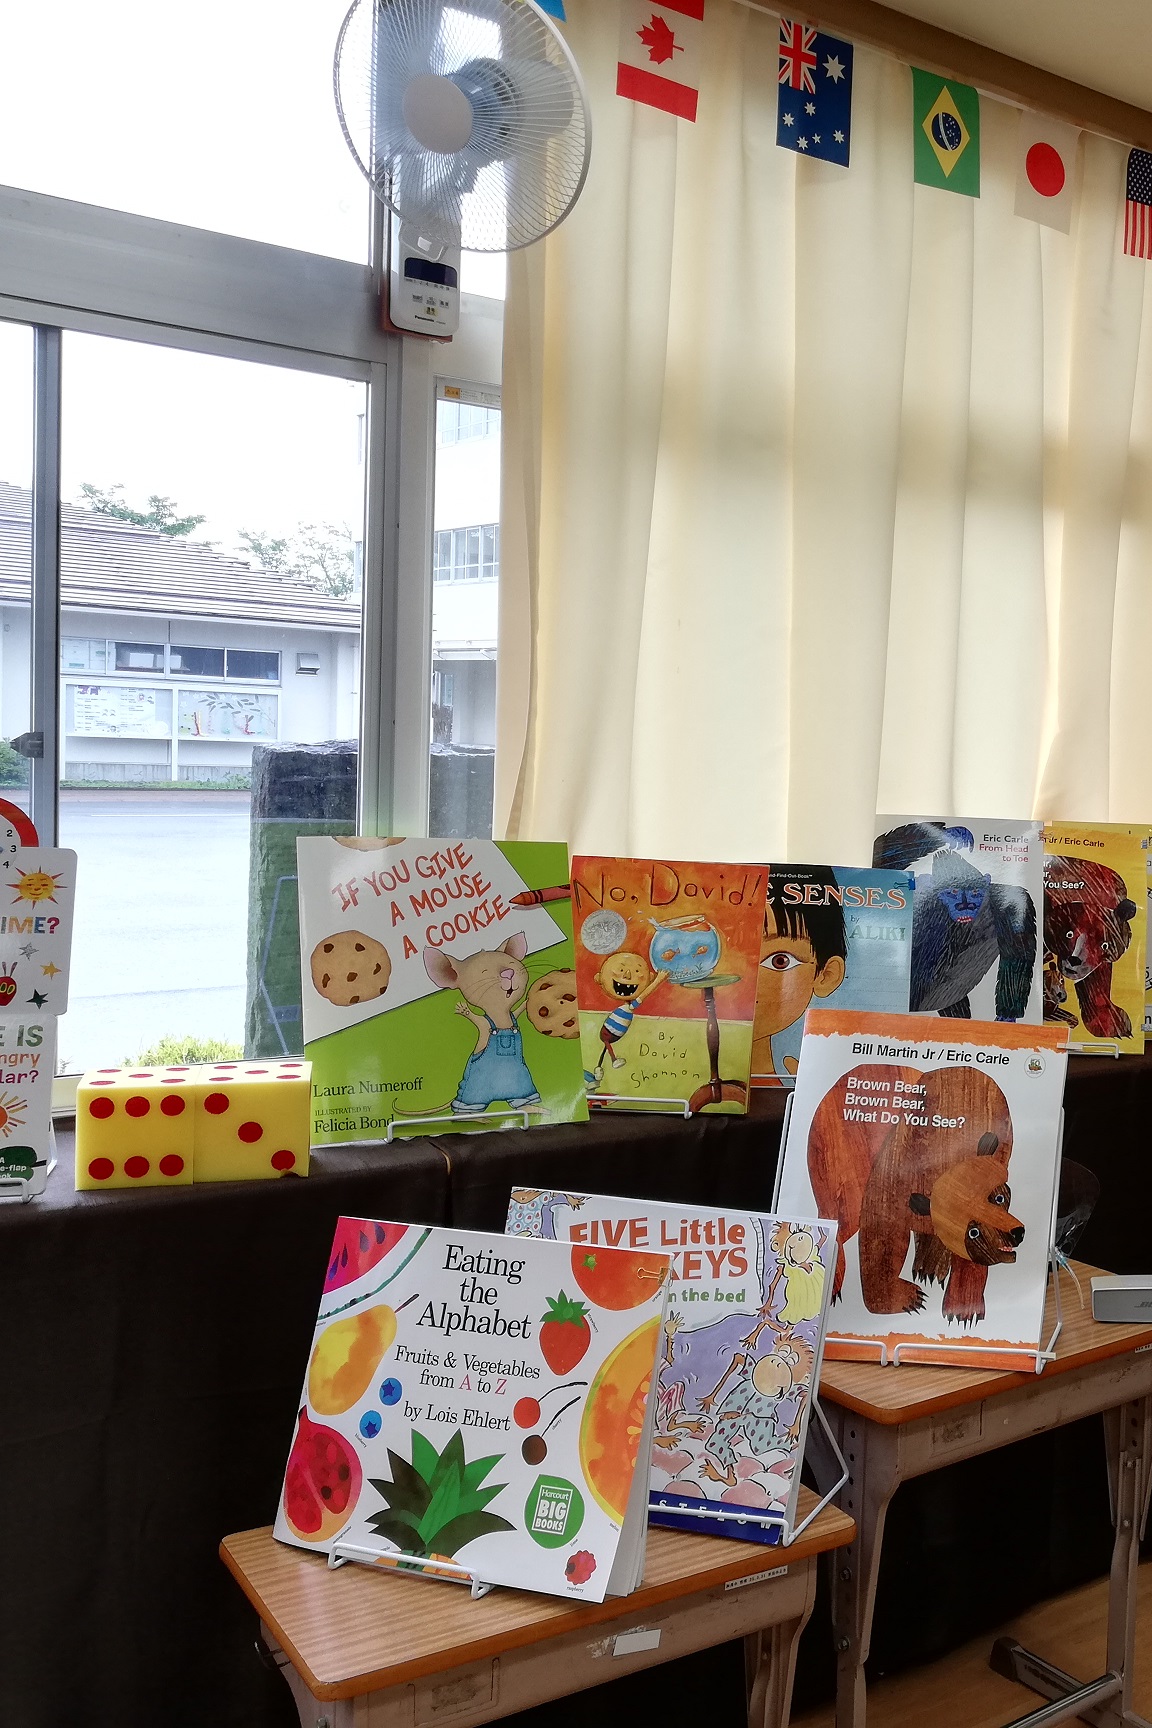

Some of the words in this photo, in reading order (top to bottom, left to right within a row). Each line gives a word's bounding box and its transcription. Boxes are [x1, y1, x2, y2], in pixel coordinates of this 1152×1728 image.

[6, 829, 13, 838] 2
[983, 834, 1001, 843] Eric
[1004, 835, 1029, 844] Carle
[1064, 837, 1081, 846] Eric
[1083, 839, 1105, 848] Carle
[10, 844, 17, 853] 3
[979, 844, 1003, 852] From
[1005, 844, 1029, 853] Head
[2, 860, 10, 869] 4
[1002, 854, 1012, 862] to
[1013, 854, 1029, 863] Toe
[331, 877, 359, 913] IF
[363, 859, 411, 898] YOU
[415, 842, 473, 879] GIVE
[573, 870, 639, 912] No,
[650, 862, 761, 907] David!
[1043, 880, 1060, 889] You
[1062, 880, 1085, 890] See?
[389, 901, 405, 928] A
[408, 871, 492, 918] MOUSE
[782, 883, 907, 910] SENSES
[0, 916, 60, 935] IME?
[402, 934, 418, 960] A
[425, 894, 511, 948] COOKIE
[850, 914, 860, 924] by
[849, 925, 906, 941] ALIKI
[17, 1025, 44, 1048] IS
[658, 1031, 675, 1044] By
[0, 1053, 41, 1069] ngry
[639, 1043, 687, 1060] David
[852, 1042, 874, 1056] Bill
[876, 1044, 918, 1059] Martin
[922, 1048, 936, 1060] Jr
[946, 1050, 972, 1063] Eric
[975, 1052, 1010, 1065] Carle
[313, 1084, 355, 1098] Laura
[359, 1077, 424, 1094] Numeroff
[630, 1068, 700, 1089] Shannon
[847, 1077, 890, 1092] Brown
[894, 1080, 928, 1096] Bear,
[314, 1106, 362, 1117] ILLUSTRATED
[362, 1105, 372, 1113] BY
[844, 1093, 888, 1108] Brown
[892, 1096, 926, 1112] Bear,
[314, 1118, 357, 1134] Felicia
[842, 1108, 877, 1124] What
[880, 1112, 900, 1125] Do
[903, 1113, 929, 1127] You
[931, 1115, 966, 1129] See?
[569, 1216, 650, 1249] FIVE
[660, 1217, 746, 1247] Little
[442, 1243, 526, 1284] Eating
[459, 1277, 498, 1305] the
[682, 1287, 710, 1302] the
[714, 1288, 746, 1303] bed
[416, 1300, 532, 1340] Alphabet
[393, 1345, 440, 1367] Fruits
[443, 1351, 457, 1368] &
[463, 1354, 541, 1380] Vegetables
[419, 1369, 455, 1389] from
[458, 1374, 472, 1391] A
[476, 1377, 491, 1393] to
[495, 1378, 508, 1395] Z
[403, 1401, 421, 1422] by
[425, 1403, 457, 1424] Lois
[461, 1408, 511, 1431] Ehlert
[541, 1488, 570, 1500] Harcourt
[537, 1499, 567, 1520] BIG
[535, 1518, 564, 1531] BOOKS
